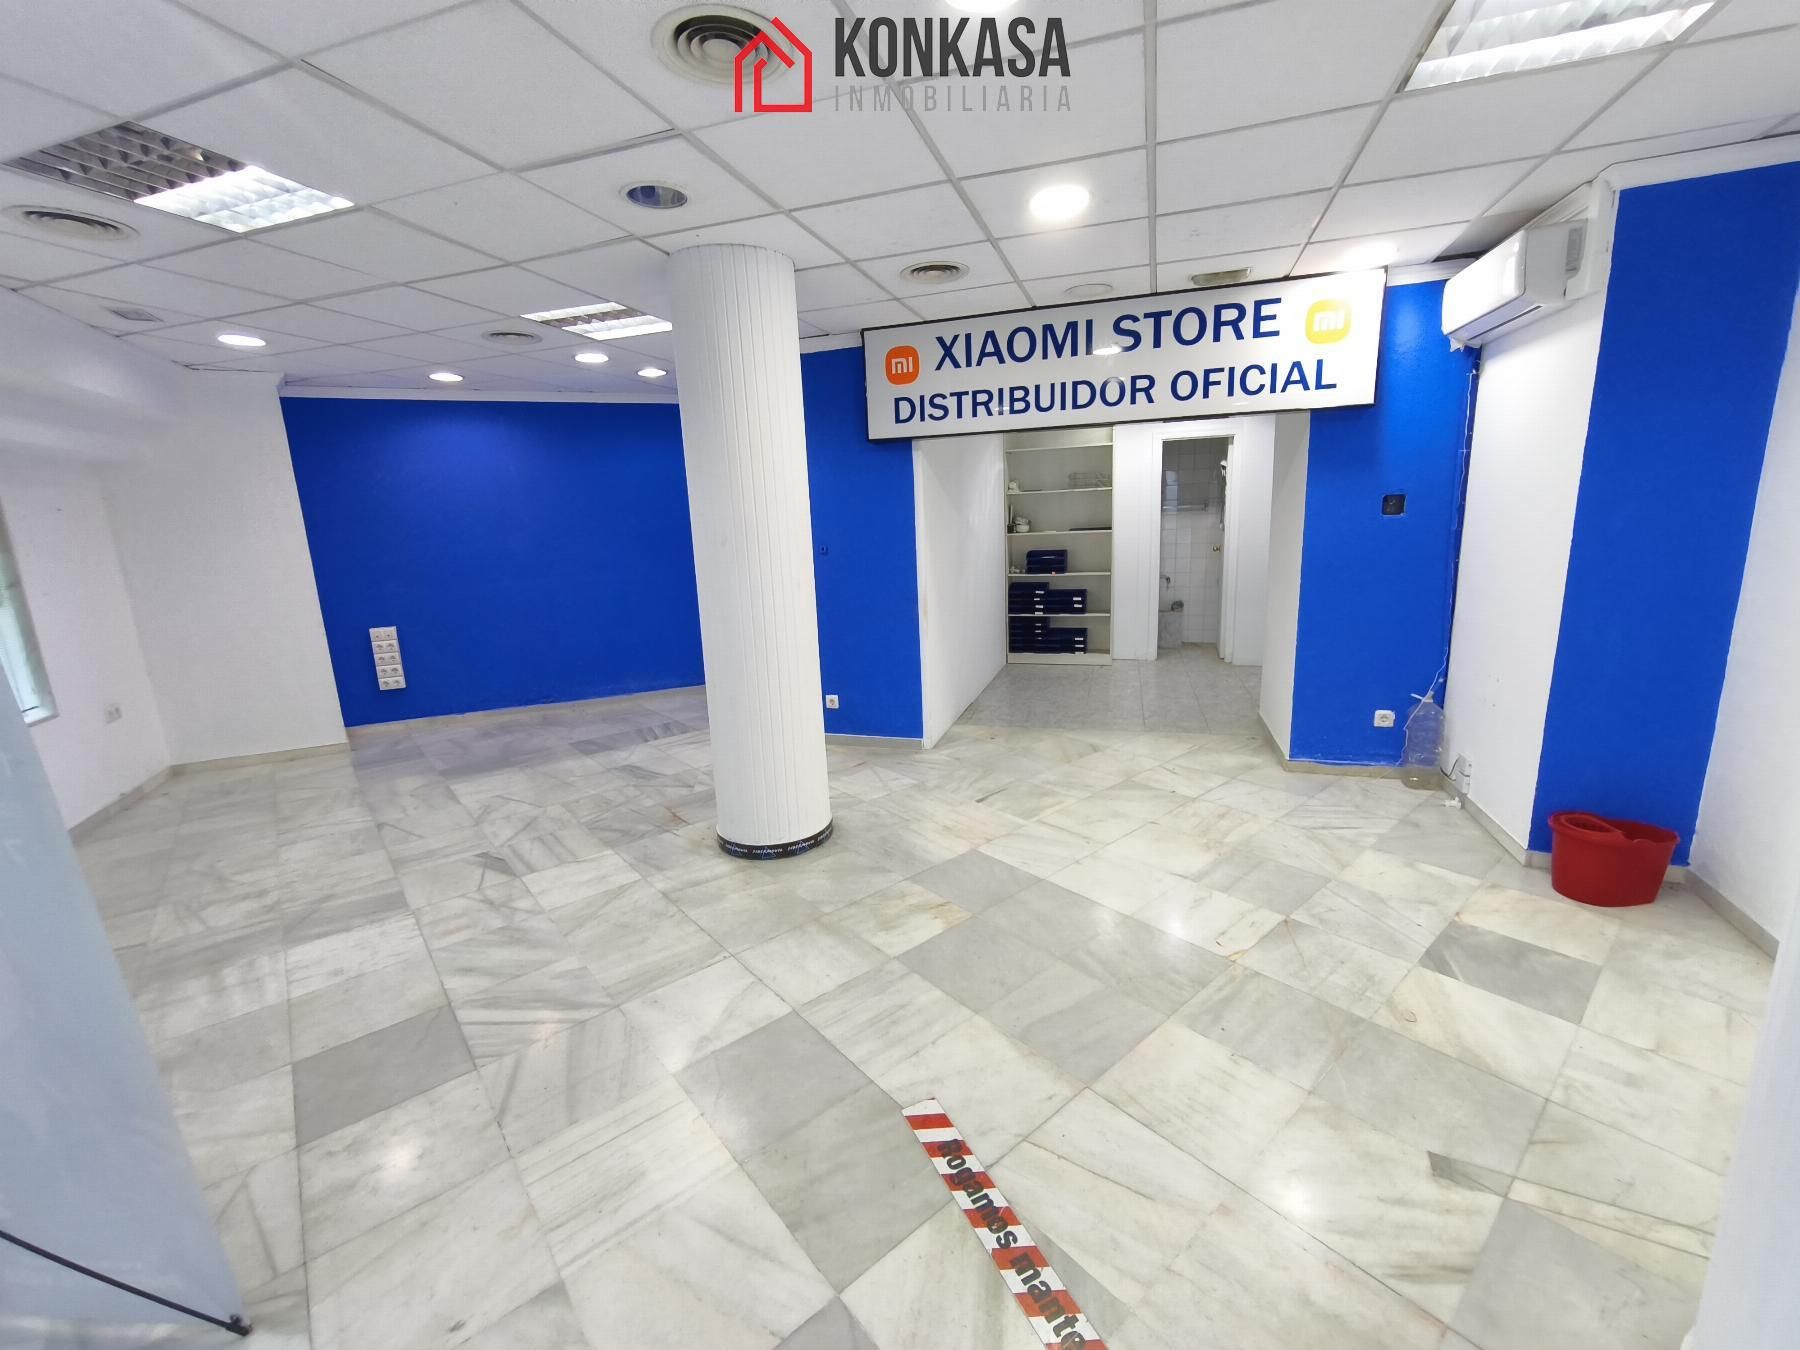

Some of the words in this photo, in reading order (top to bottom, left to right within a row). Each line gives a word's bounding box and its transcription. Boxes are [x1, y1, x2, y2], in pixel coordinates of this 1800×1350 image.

[934, 318, 1094, 371] XIAOMI
[1112, 297, 1282, 353] STORE
[894, 373, 1156, 425] DISTRIBUIDOR
[1170, 358, 1337, 401] OFICIAL
[937, 1138, 1018, 1249] Rogamos
